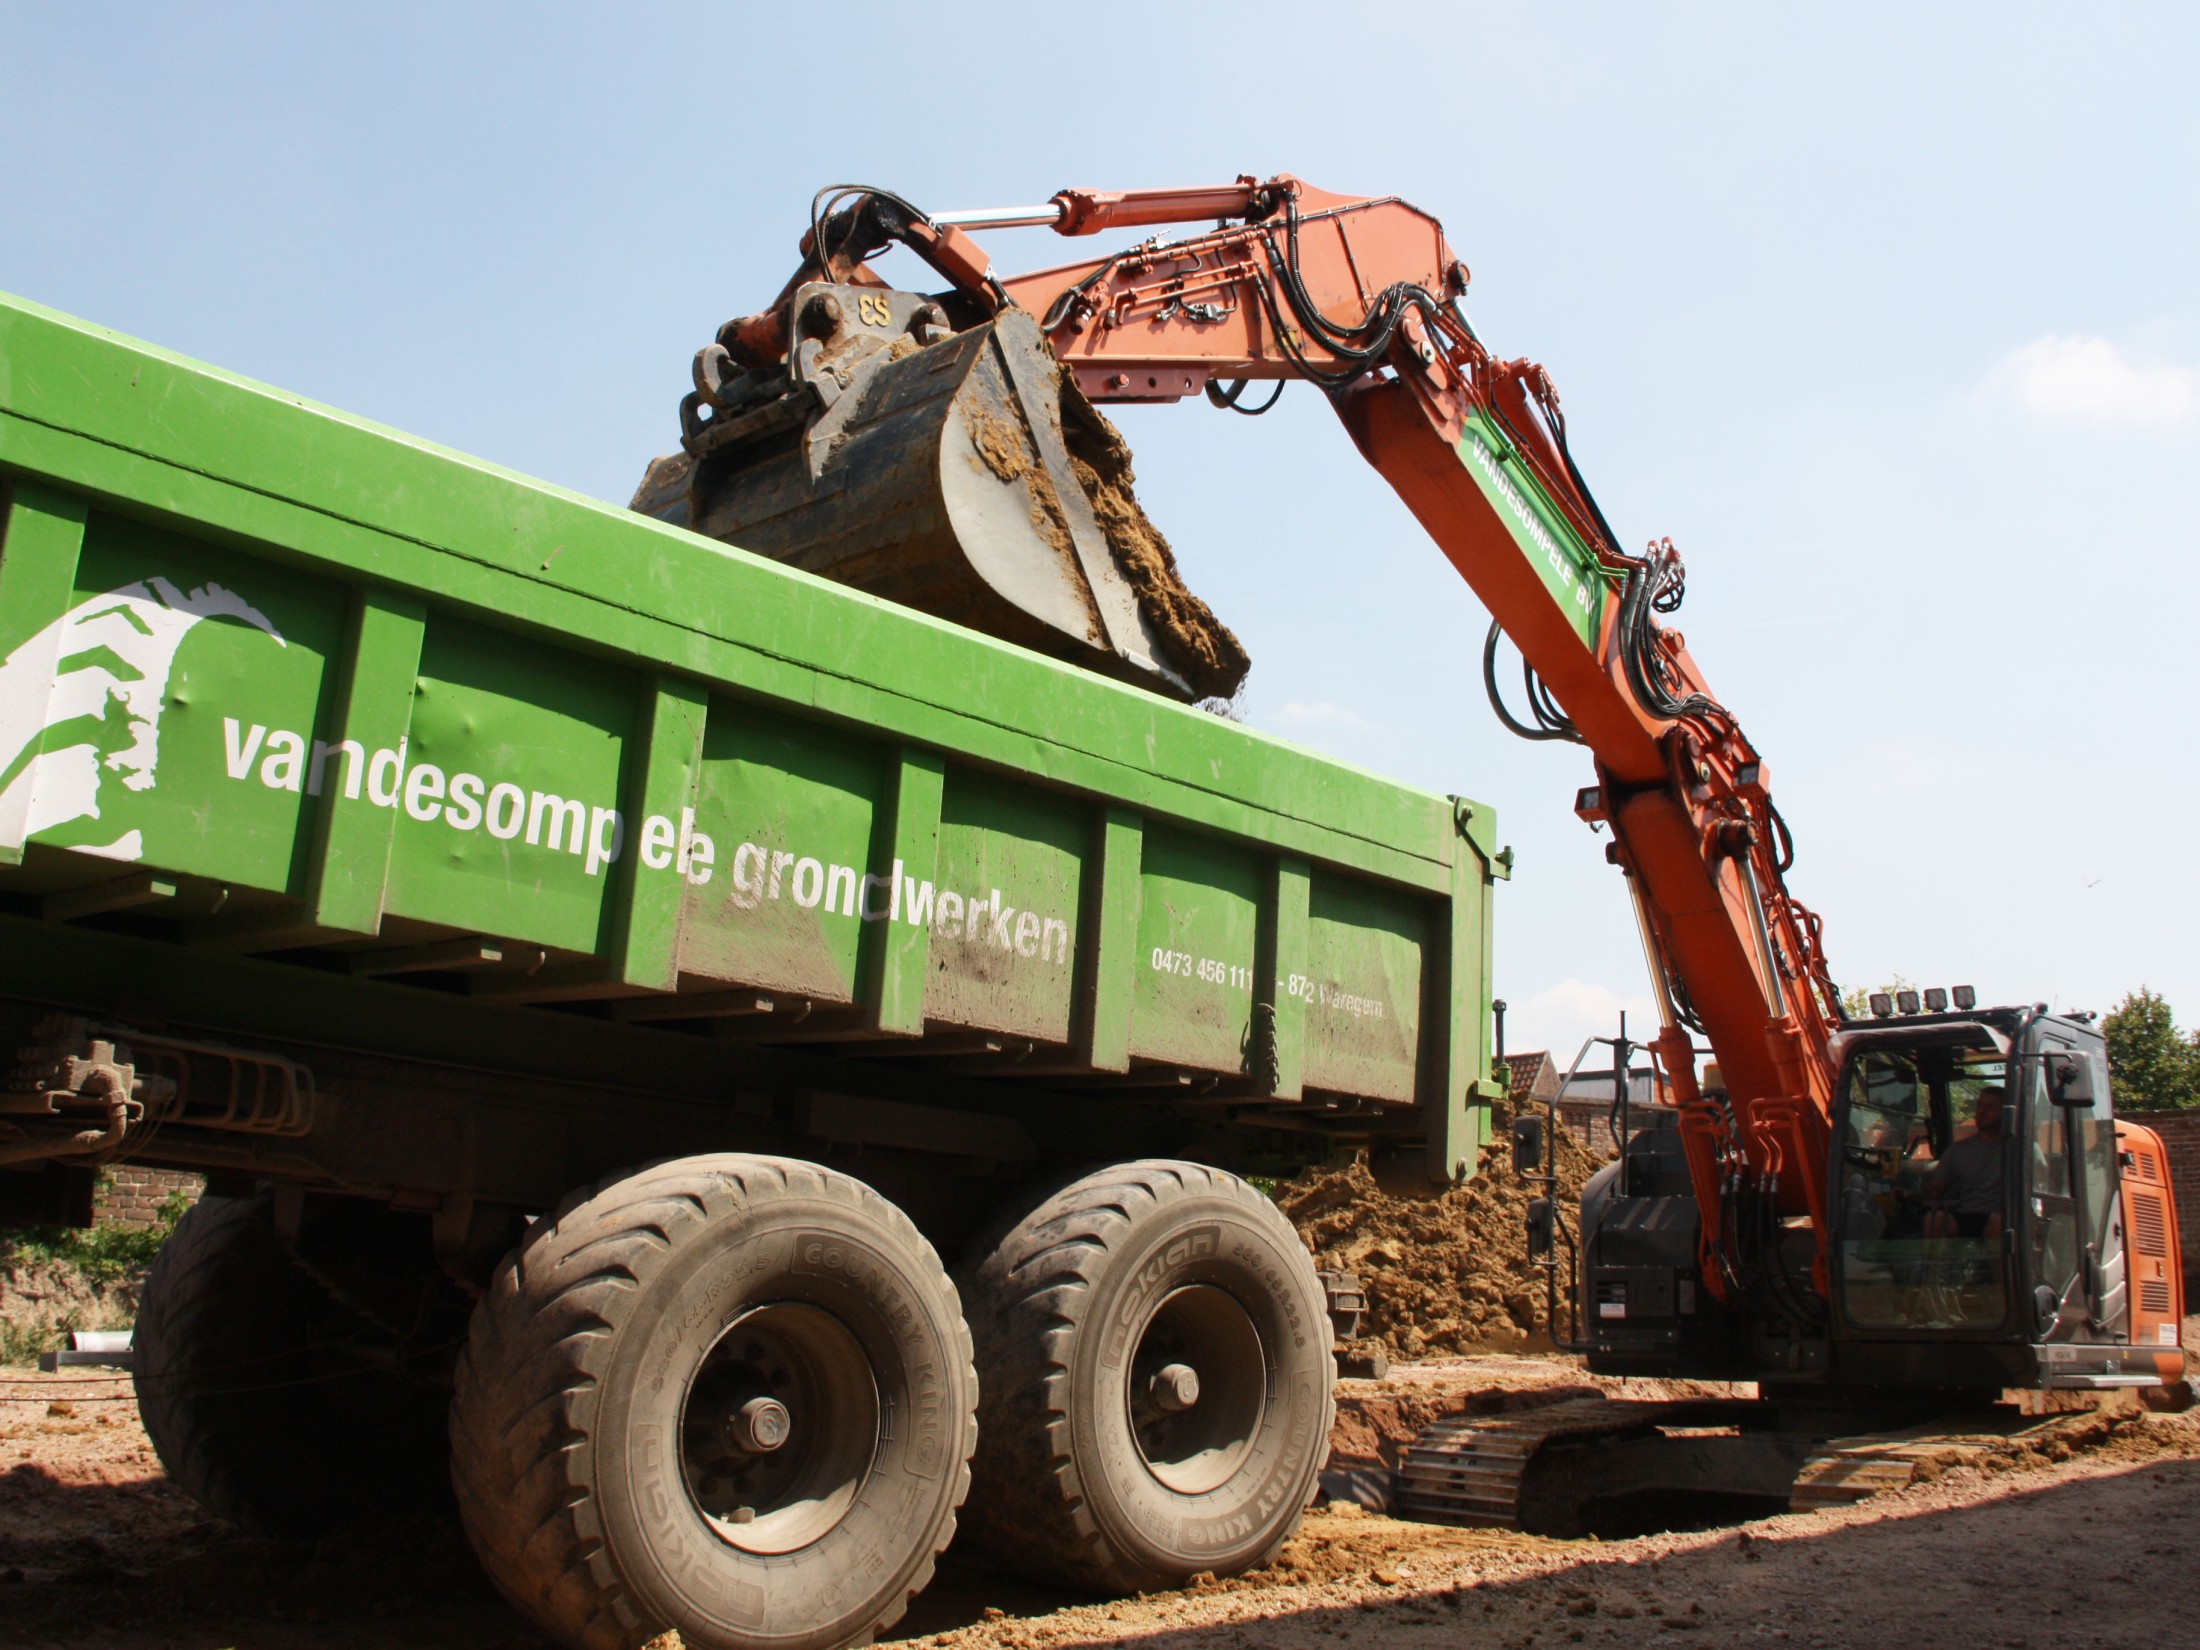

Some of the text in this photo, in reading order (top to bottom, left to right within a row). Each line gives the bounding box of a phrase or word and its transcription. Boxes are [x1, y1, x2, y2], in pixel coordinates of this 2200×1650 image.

[1473, 434, 1574, 586] VANDESOMPELE
[730, 841, 1069, 965] grondwerken
[1152, 948, 1192, 977] 0473
[1196, 958, 1226, 984] 456
[1320, 984, 1383, 1018] Waregem
[805, 1243, 937, 1465] COUNTRY KING
[1188, 1382, 1311, 1545] COUNTRY KING
